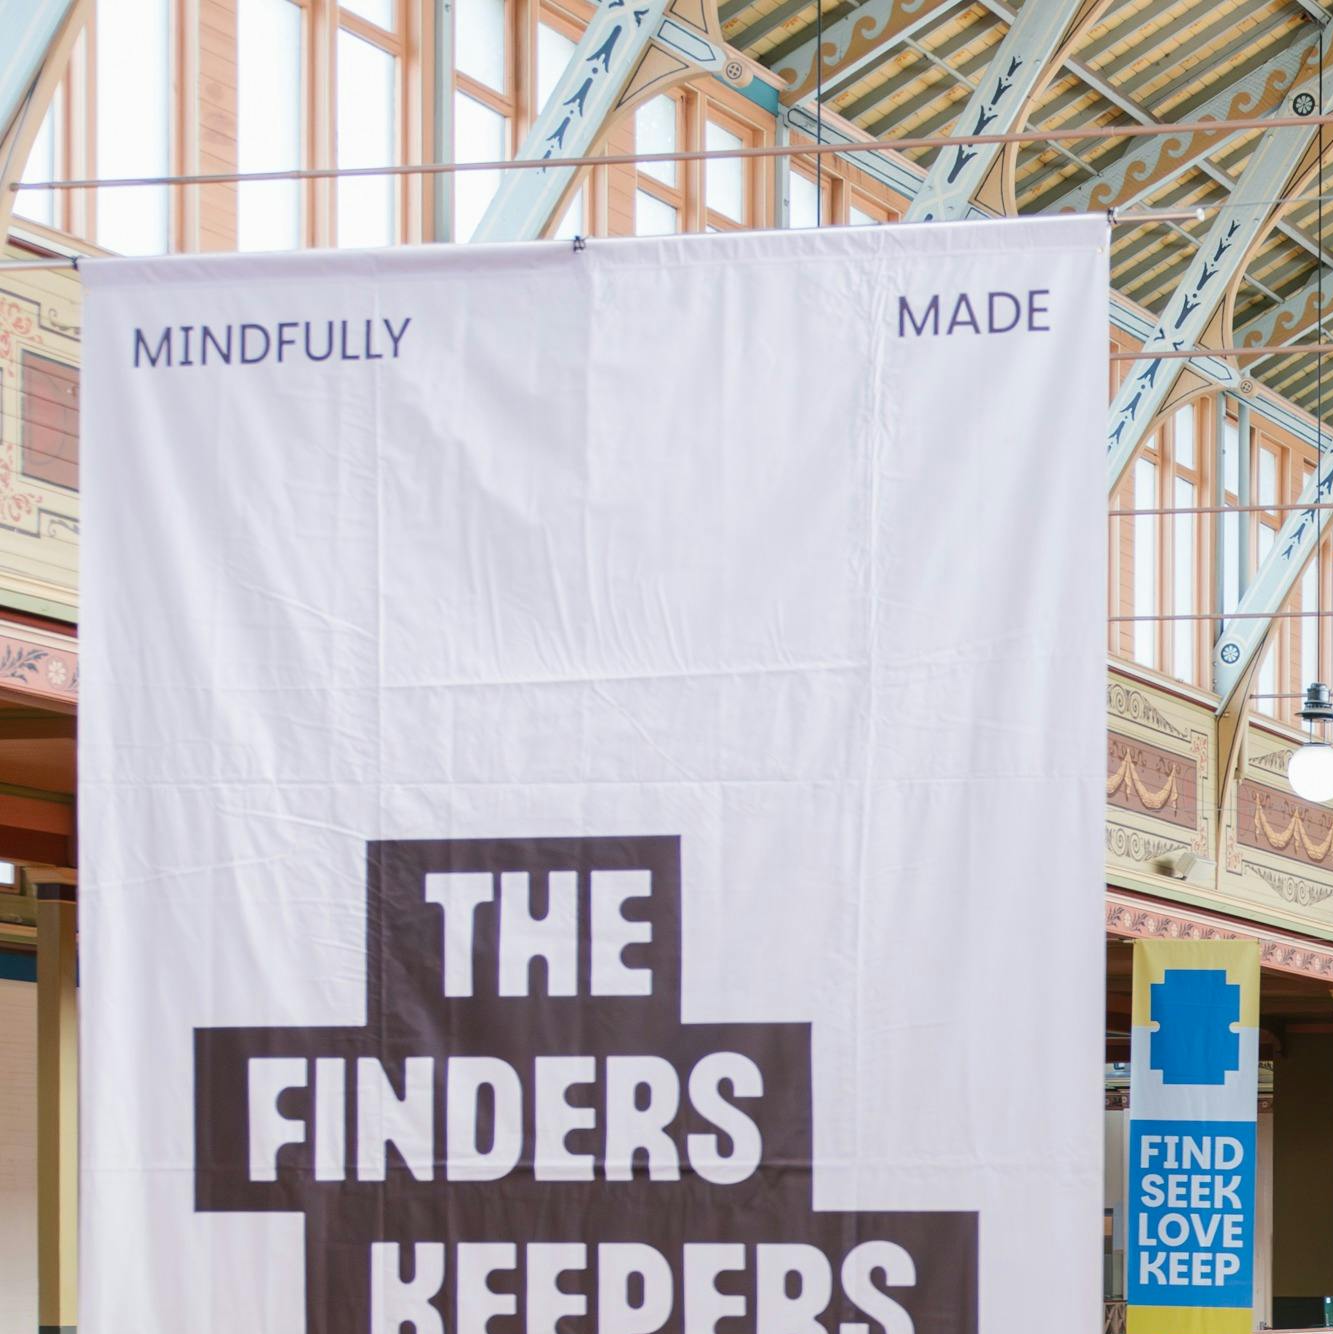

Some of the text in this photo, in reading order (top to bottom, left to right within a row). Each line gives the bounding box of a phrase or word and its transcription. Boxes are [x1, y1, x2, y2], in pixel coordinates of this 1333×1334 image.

[133, 289, 1051, 368] MINDFULLY MADE
[425, 869, 652, 998] THE
[248, 1051, 764, 1186] FINDERS
[1140, 1135, 1244, 1170] FIND
[1140, 1173, 1242, 1209] SEEK
[1138, 1212, 1244, 1247] LOVE
[1139, 1251, 1241, 1286] KEEP
